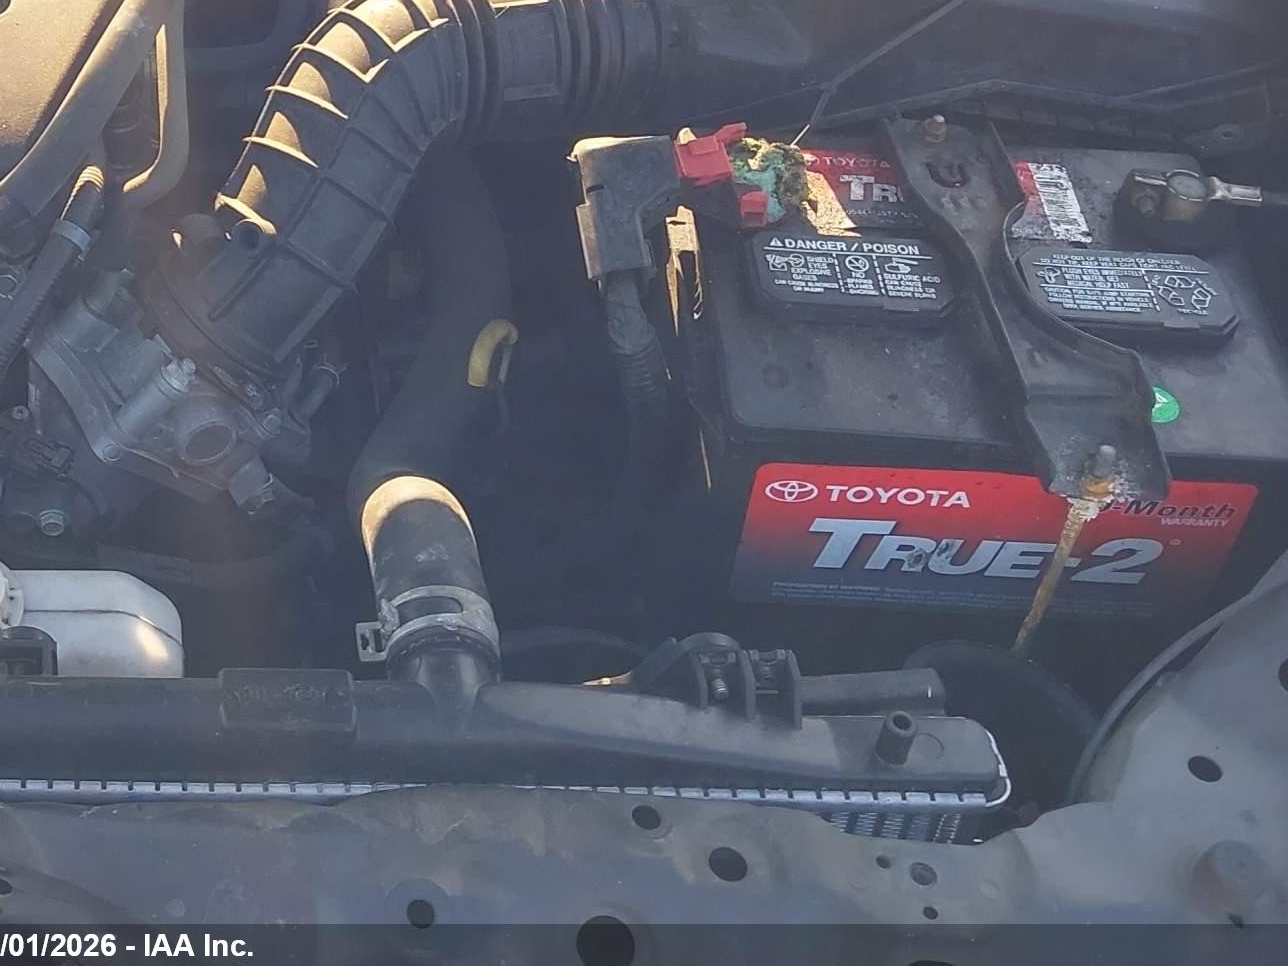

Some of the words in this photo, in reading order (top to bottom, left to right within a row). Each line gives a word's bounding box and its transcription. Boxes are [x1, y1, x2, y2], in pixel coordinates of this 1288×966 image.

[822, 155, 891, 169] TOYOTA
[784, 238, 847, 252] DANGER
[863, 242, 920, 255] POISON
[825, 485, 971, 509] TOYOTA
[1160, 517, 1230, 528] WARRANTY
[808, 517, 1164, 584] TRUE-2
